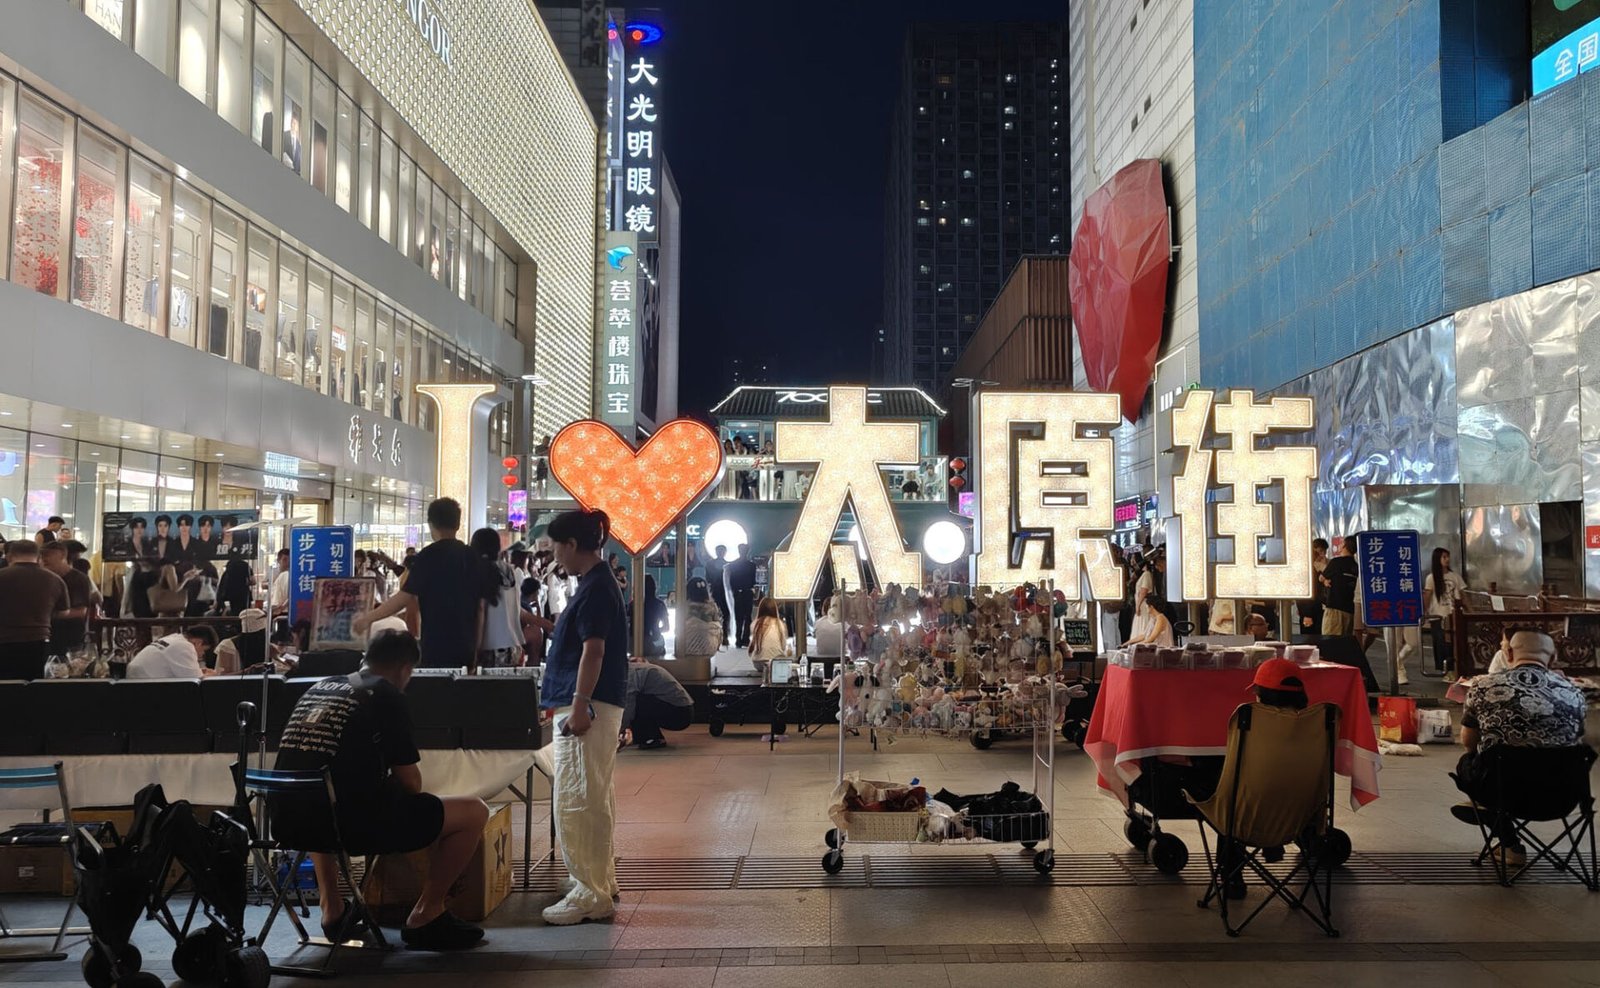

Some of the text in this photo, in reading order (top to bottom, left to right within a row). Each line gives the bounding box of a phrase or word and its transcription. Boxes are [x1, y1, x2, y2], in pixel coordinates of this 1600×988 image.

[400, 0, 453, 72] NGOR
[1554, 32, 1599, 81] 全国
[625, 57, 659, 232] 大光明眼镜
[607, 279, 632, 413] 荟萃楼珠宝
[773, 384, 1318, 600] 太原街
[298, 532, 316, 592] 步行街
[329, 531, 345, 576] 一切车
[1368, 537, 1387, 594] 步行街
[1397, 535, 1414, 592] 一切车辆
[1370, 599, 1417, 620] 禁行
